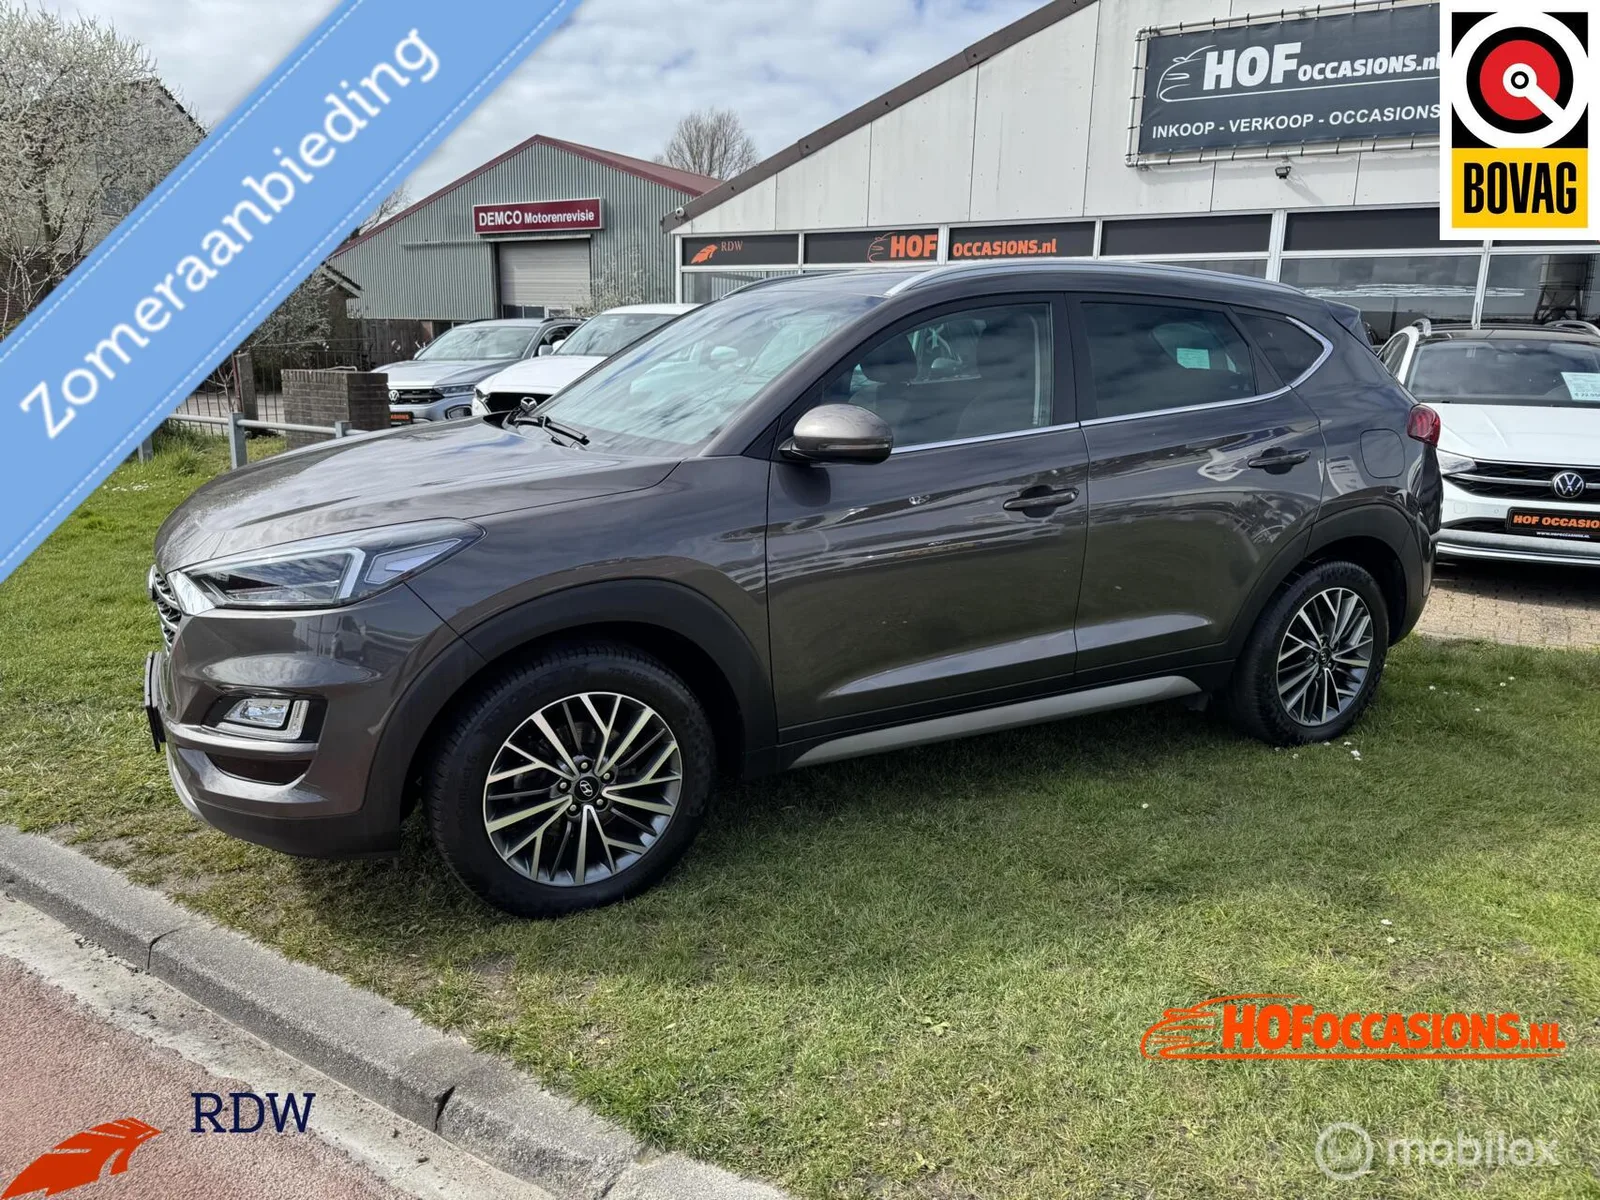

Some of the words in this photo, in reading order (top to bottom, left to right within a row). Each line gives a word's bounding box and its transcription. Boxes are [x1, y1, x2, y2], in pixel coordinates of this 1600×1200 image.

[1152, 121, 1215, 139] INKOOP
[1228, 113, 1313, 134] VERKOOP
[1328, 104, 1440, 126] OCCASIONS
[479, 210, 522, 226] DEMCO
[524, 209, 595, 224] Motorenrevisie
[721, 240, 743, 252] RDW
[890, 234, 938, 258] HOF
[953, 238, 1057, 257] OCCASIONS.nl
[1513, 515, 1540, 524] HOF
